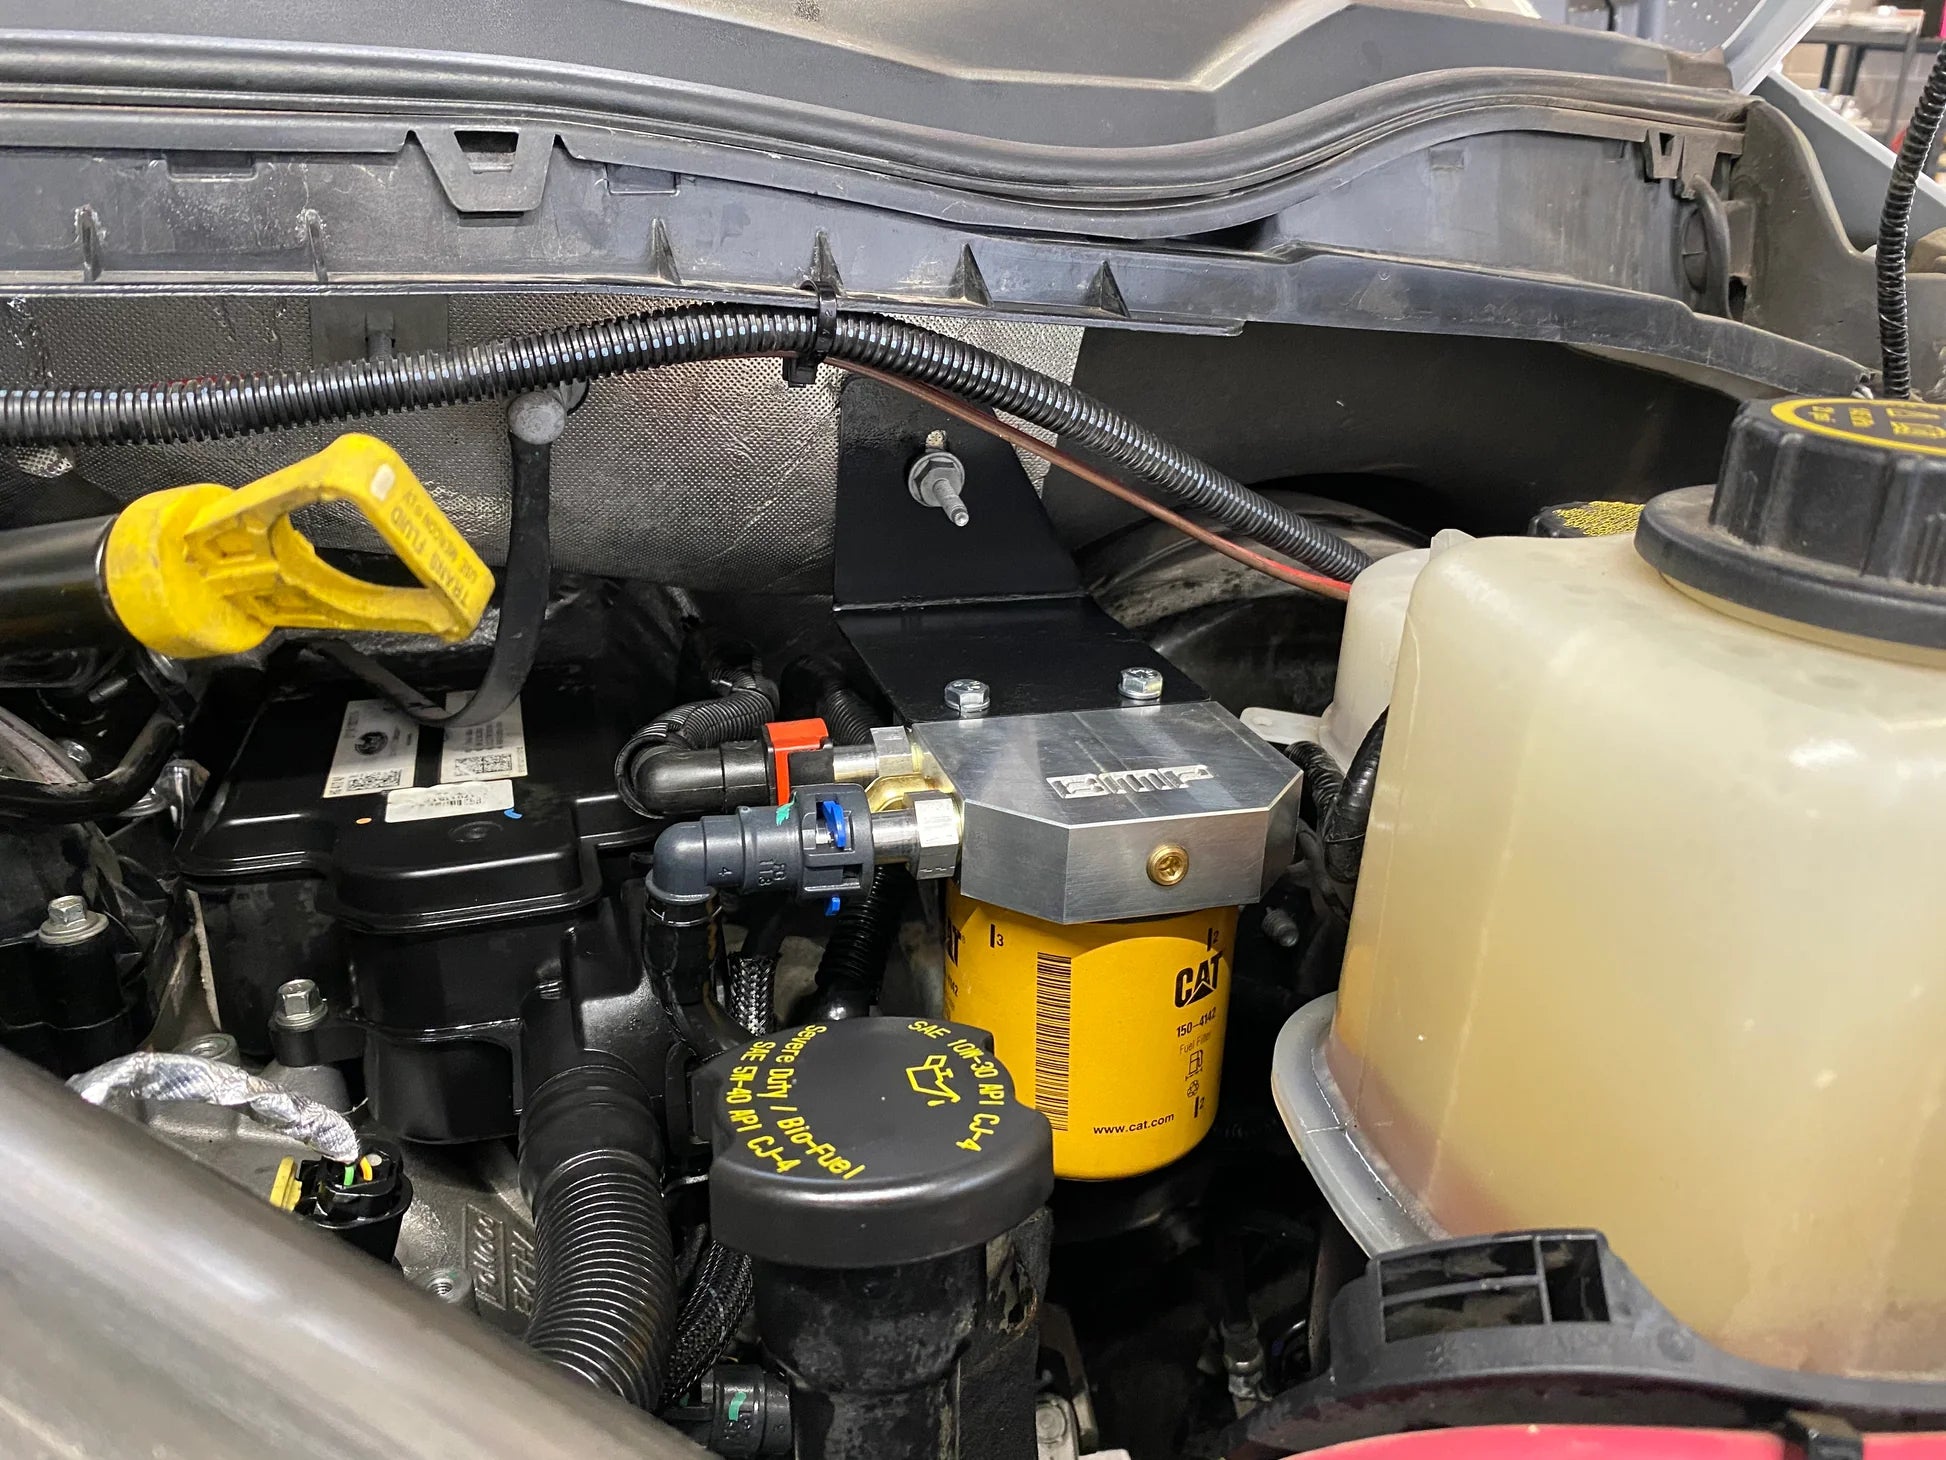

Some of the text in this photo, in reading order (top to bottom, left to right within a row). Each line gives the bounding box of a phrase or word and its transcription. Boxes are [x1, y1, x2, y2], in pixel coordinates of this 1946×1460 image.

[390, 506, 427, 555] FLUID
[1174, 949, 1224, 1008] CAT
[775, 1024, 828, 1063] Severe
[1179, 1038, 1195, 1055] Fuel
[725, 1040, 802, 1173] SAE 5W-40 API CJ-4
[756, 1067, 795, 1099] Duty
[908, 1020, 1005, 1152] SAE 10W-30 API CJ-4
[777, 1116, 866, 1180] Bio-Fuel
[1092, 1113, 1176, 1135] www.cat.com
